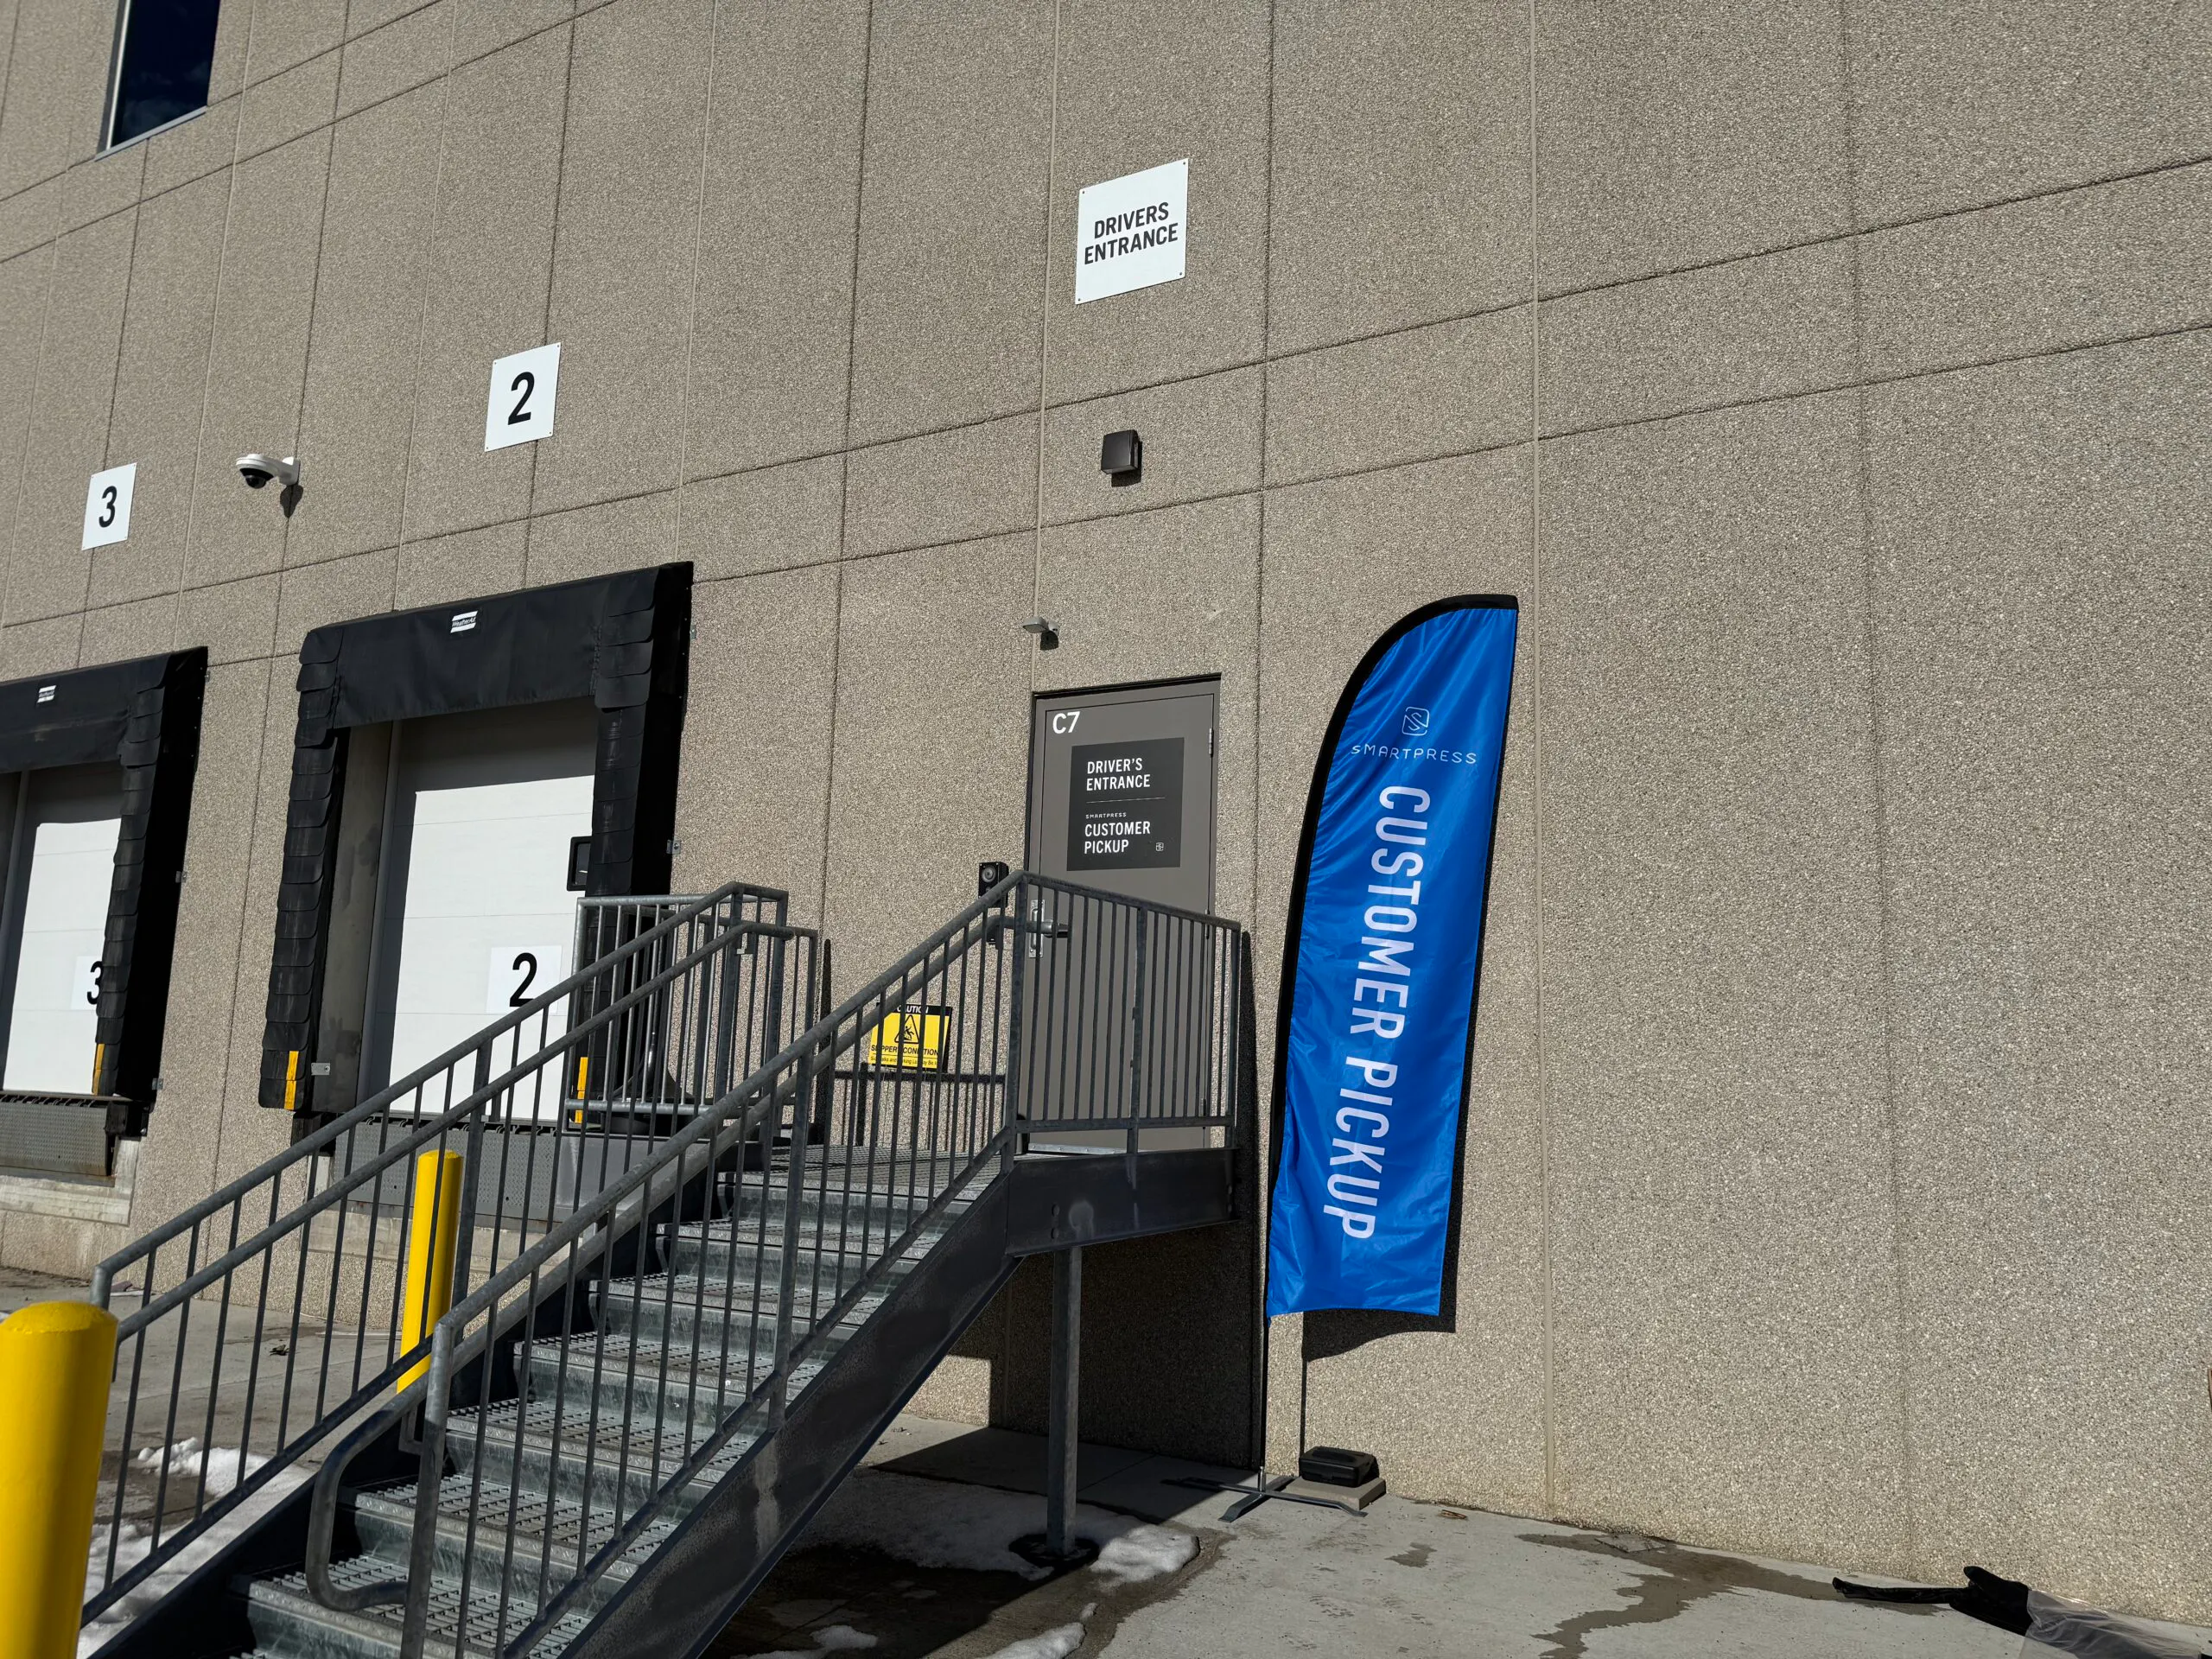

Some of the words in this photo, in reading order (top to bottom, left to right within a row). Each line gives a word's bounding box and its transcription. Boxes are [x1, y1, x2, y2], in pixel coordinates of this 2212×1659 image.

[1094, 201, 1169, 239] DRIVERS
[1084, 222, 1179, 265] ENTRANCE
[507, 372, 535, 425] 2
[99, 486, 118, 528] 3
[1052, 711, 1080, 734] C7
[1087, 758, 1142, 774] DRIVER'S
[1351, 743, 1477, 765] SMARTPRESS
[1086, 774, 1151, 791] ENTRANCE
[1084, 821, 1151, 836] CUSTOMER
[1084, 839, 1129, 854] PICKUP
[1350, 785, 1431, 1039] CUSTOMER
[86, 961, 104, 1005] 3
[509, 952, 537, 1007] 2
[897, 1004, 929, 1014] CUTION
[903, 1046, 939, 1055] CONTION
[1323, 1056, 1398, 1238] PICKUP
